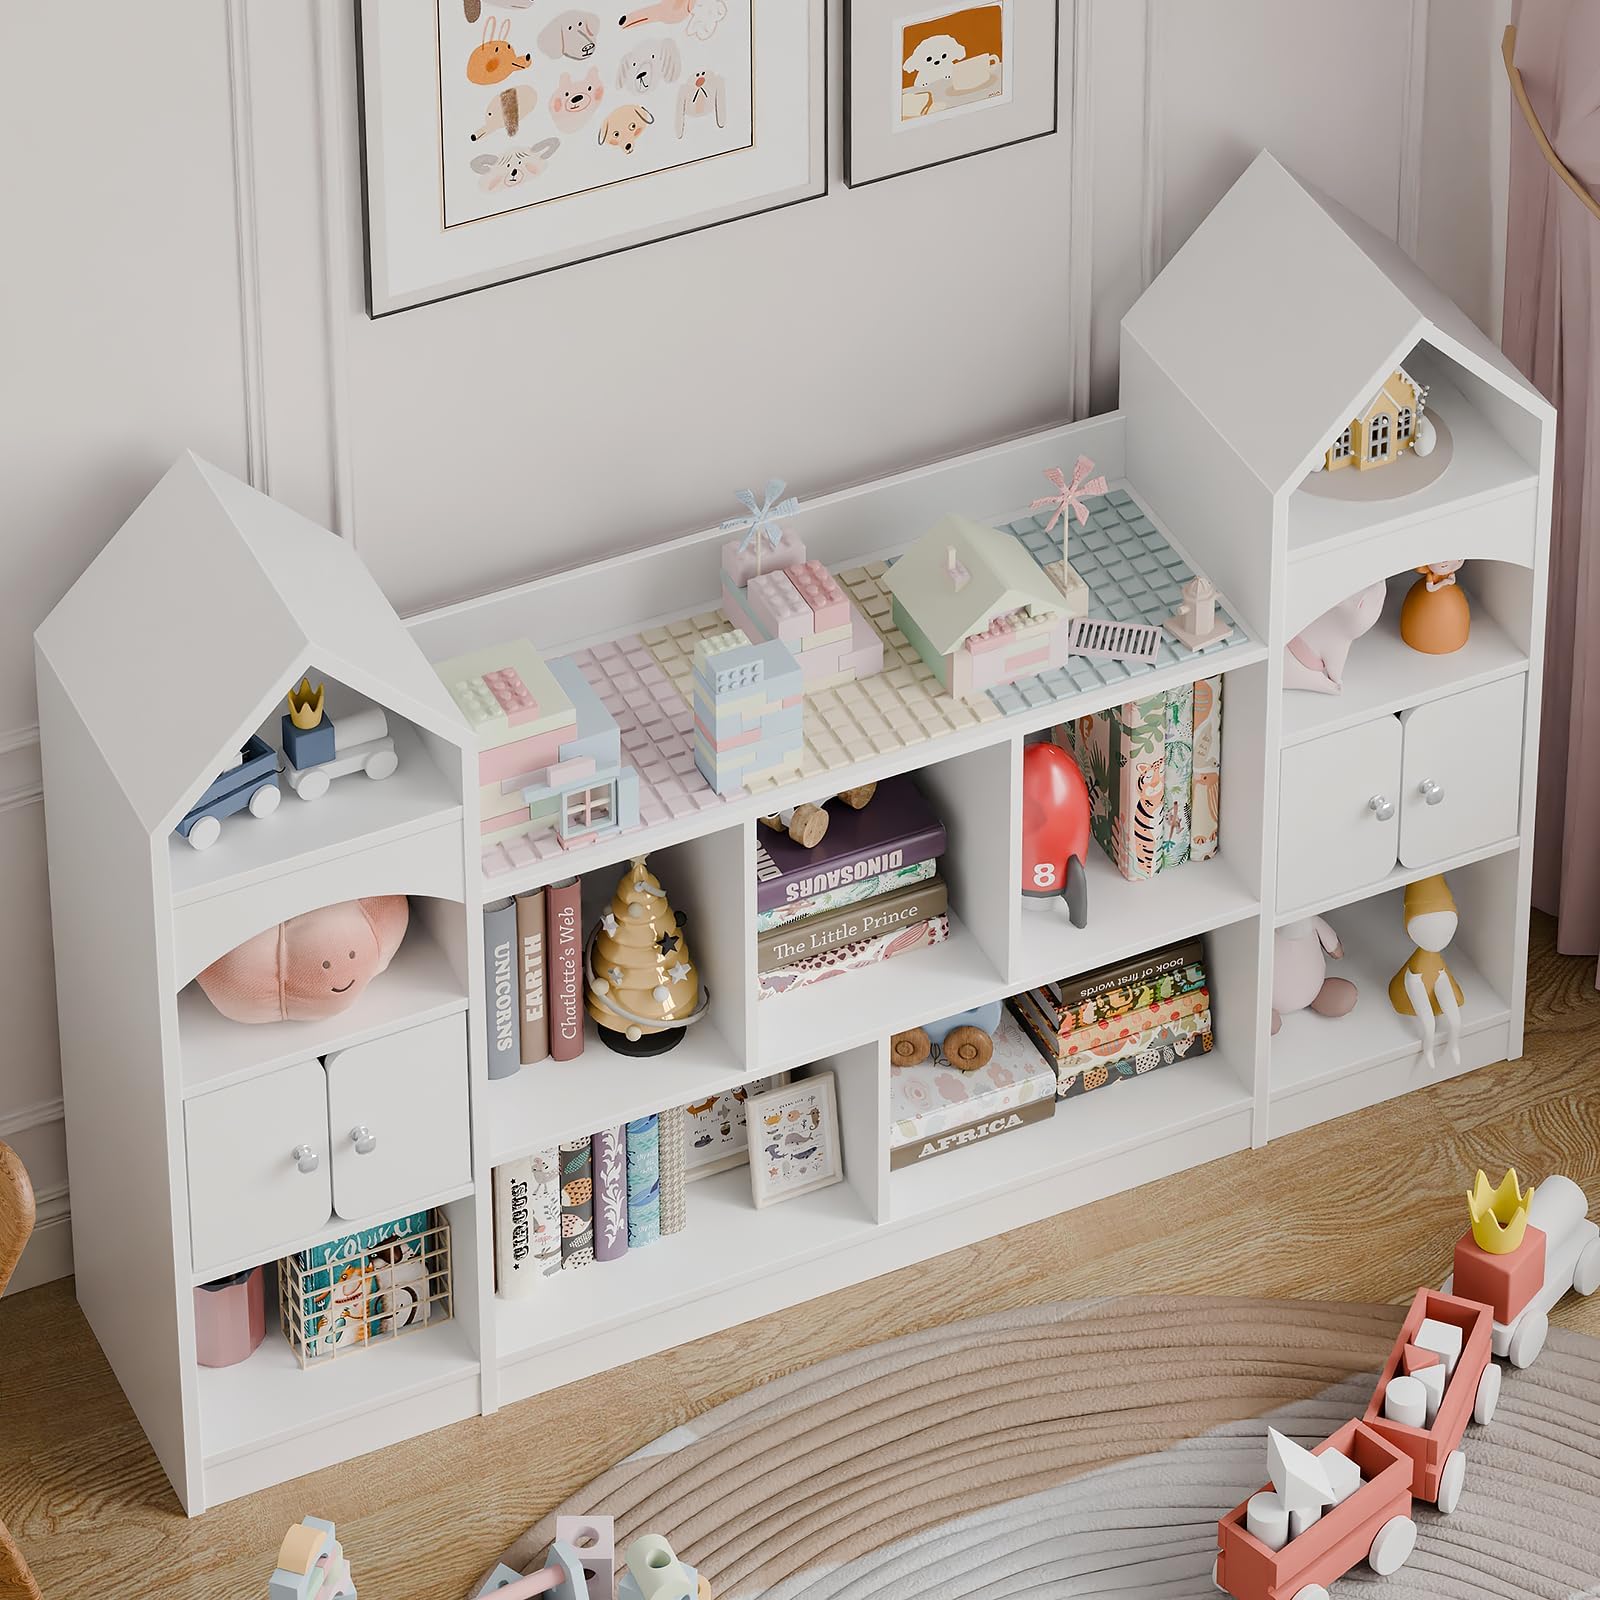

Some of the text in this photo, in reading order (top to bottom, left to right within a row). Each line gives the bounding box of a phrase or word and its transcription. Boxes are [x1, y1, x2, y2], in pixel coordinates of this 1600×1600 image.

[786, 849, 903, 902] DINOSAURS
[1033, 863, 1056, 887] 8
[558, 907, 575, 945] Web
[773, 905, 919, 960] The Little Prince
[494, 941, 512, 1051] UNICORNS
[524, 933, 544, 1022] EARTH
[1080, 957, 1184, 997] book of first words
[918, 1113, 1024, 1159] AFRICA
[511, 1181, 529, 1261] CIRCUS
